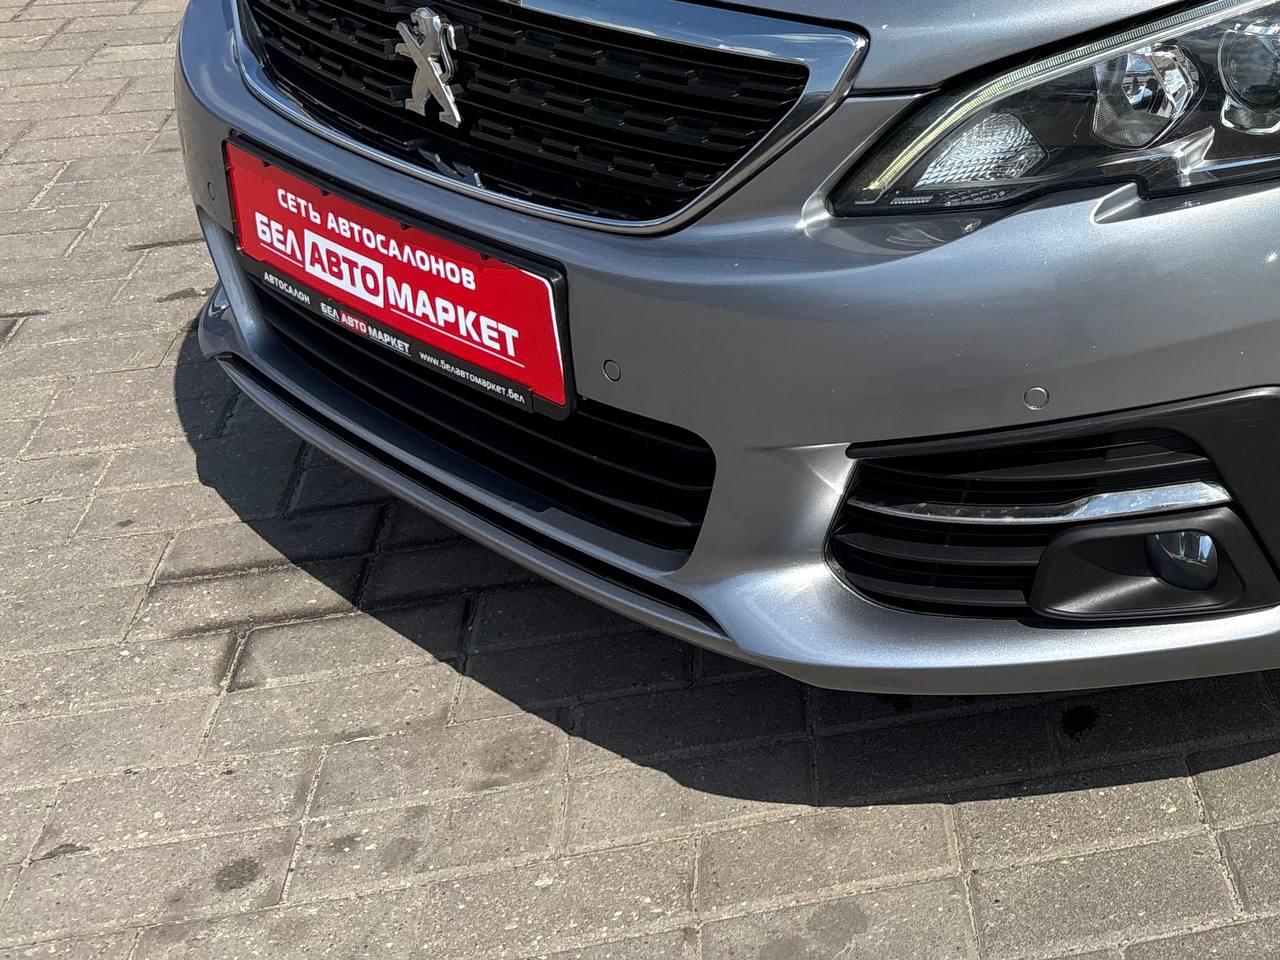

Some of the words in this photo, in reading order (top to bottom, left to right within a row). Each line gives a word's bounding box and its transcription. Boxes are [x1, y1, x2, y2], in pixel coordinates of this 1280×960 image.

[277, 188, 321, 224] СЕТЬ
[327, 211, 476, 291] АВТОСАЛОНОВ
[264, 271, 311, 305] АВТОСАЛОН
[368, 325, 410, 353] МАРКЕТ
[419, 350, 525, 404] www.белавтомаркет.бел
